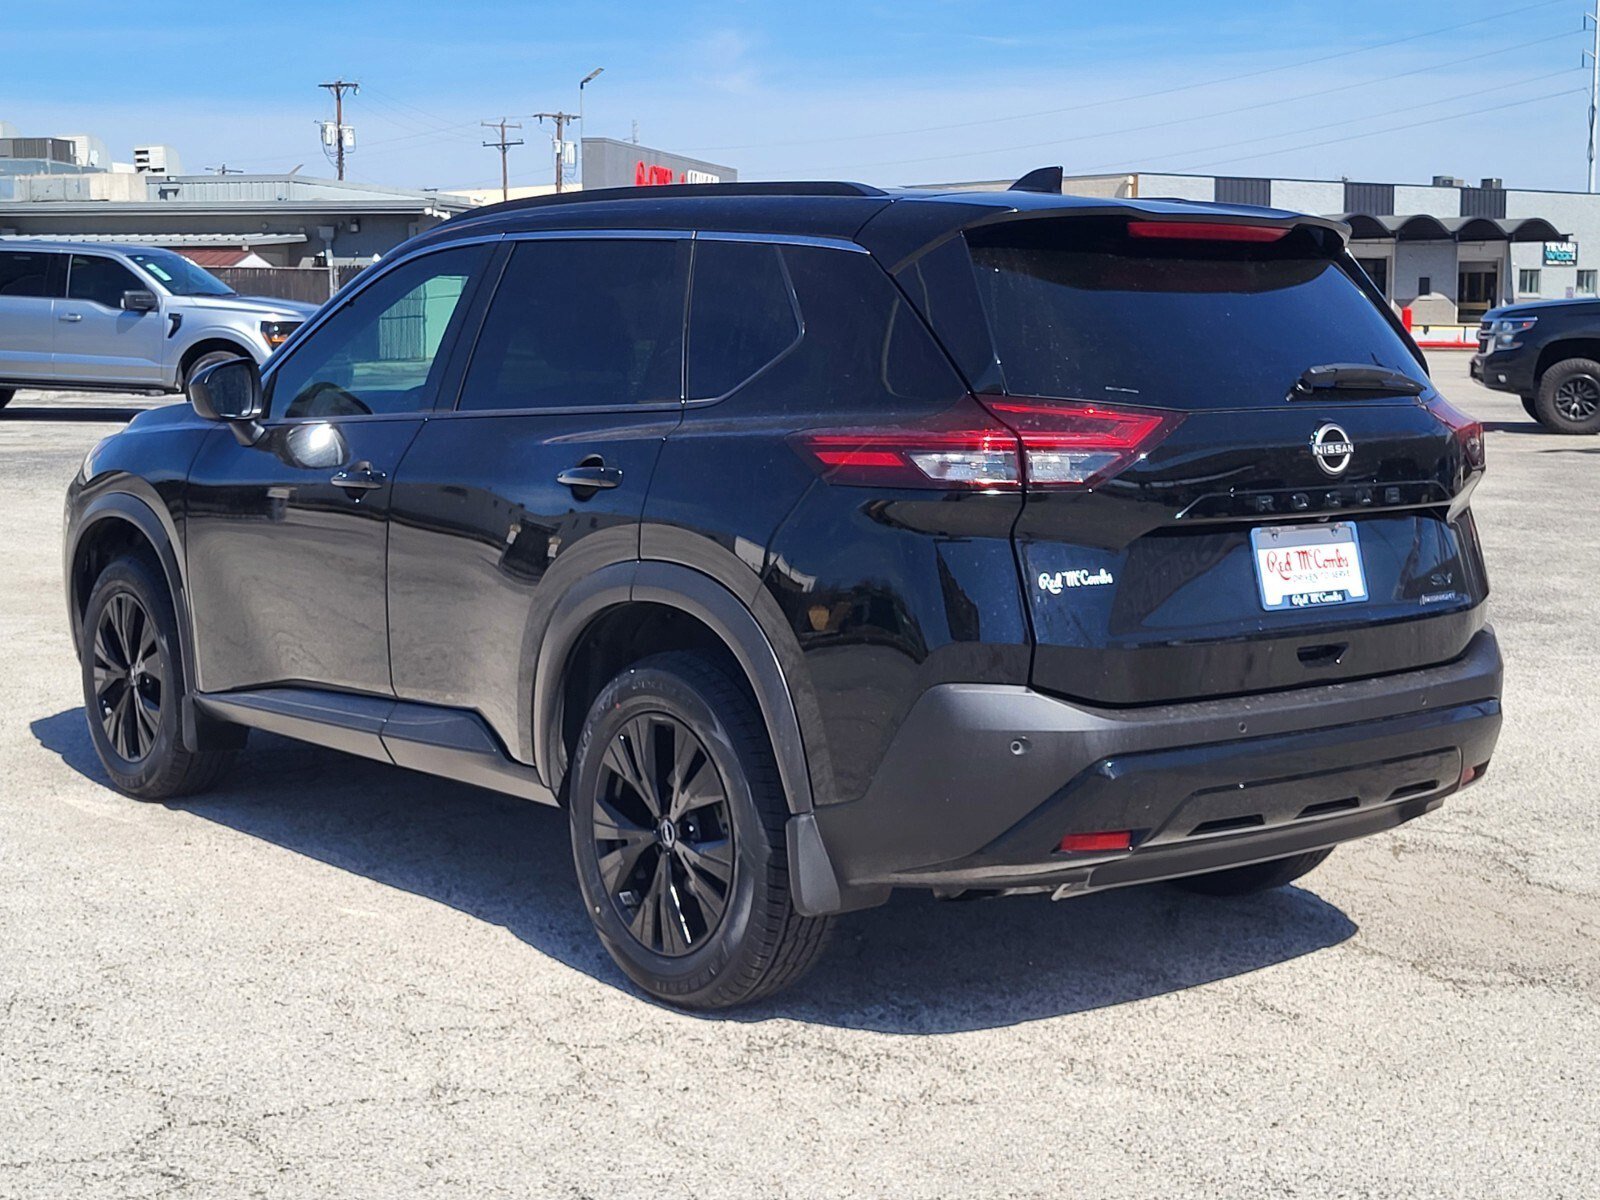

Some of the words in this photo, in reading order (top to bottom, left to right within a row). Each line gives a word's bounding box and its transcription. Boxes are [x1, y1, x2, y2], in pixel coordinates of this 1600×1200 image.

[1313, 443, 1354, 455] NISSAN
[1254, 487, 1400, 512] ROGUE
[1266, 551, 1292, 580] Red
[1038, 572, 1063, 594] Red
